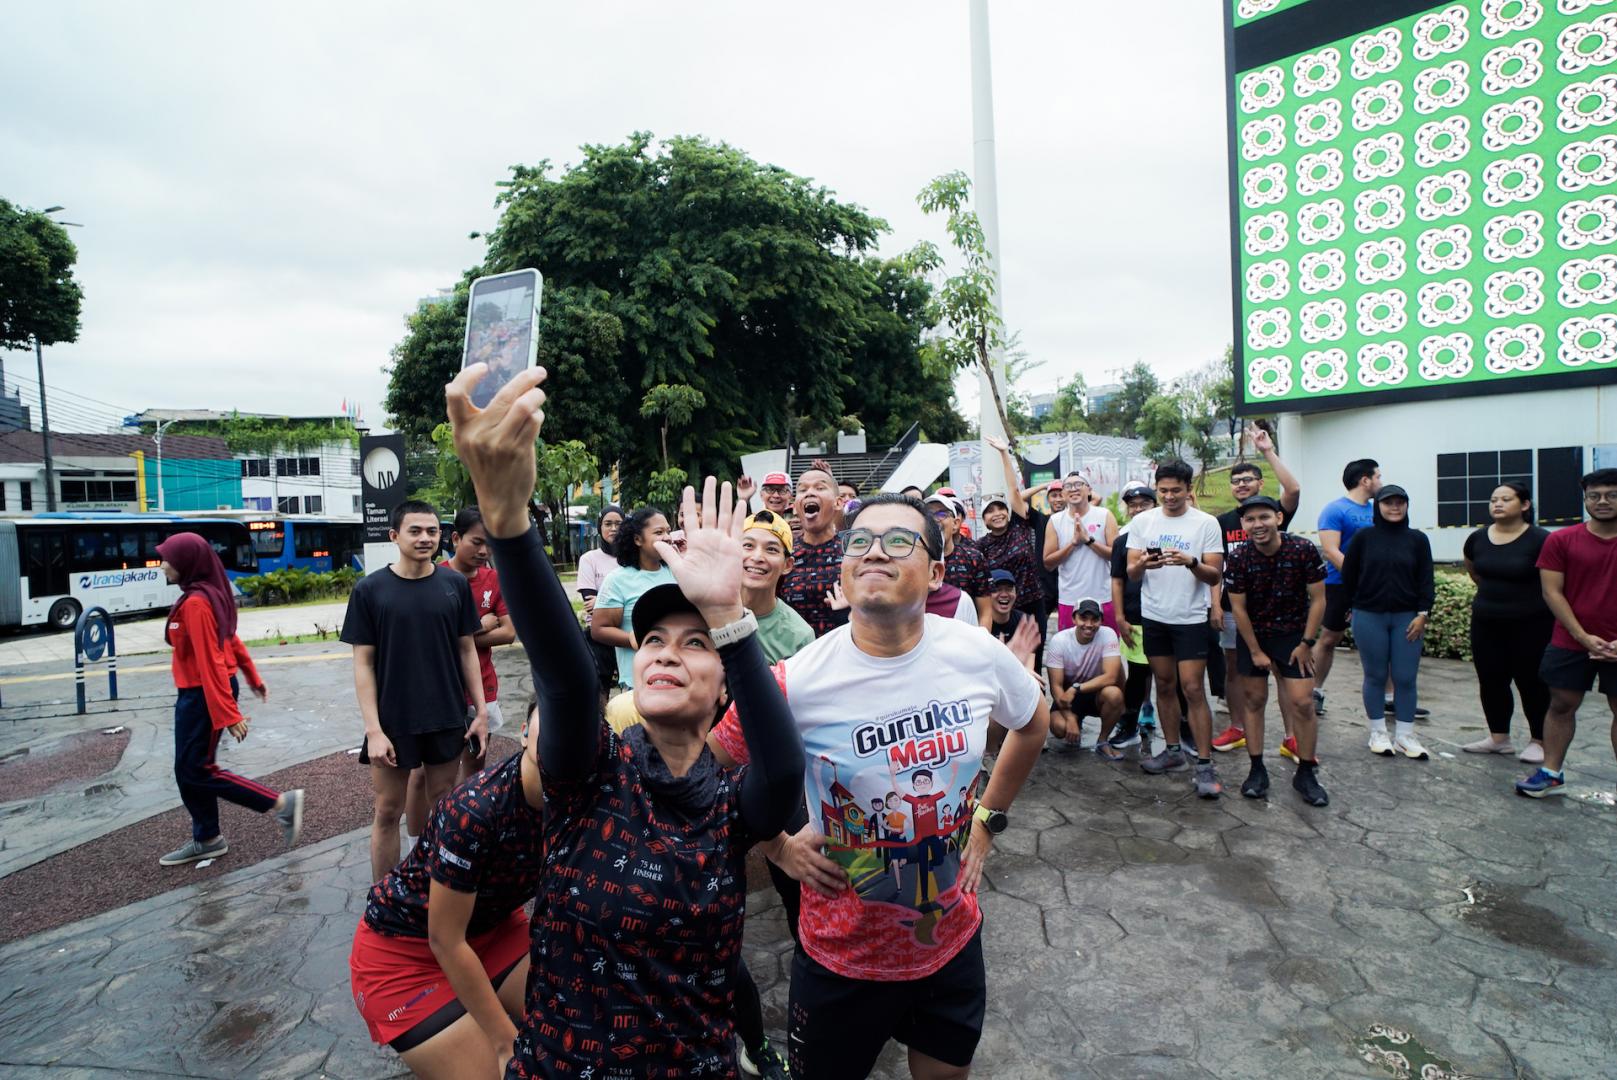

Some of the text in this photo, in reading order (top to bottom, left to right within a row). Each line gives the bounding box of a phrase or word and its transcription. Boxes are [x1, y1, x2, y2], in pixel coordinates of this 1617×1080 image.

[93, 570, 158, 588] transjakarta
[856, 702, 970, 755] Guruku
[890, 730, 964, 768] Maju
[632, 868, 663, 881] FINISHER
